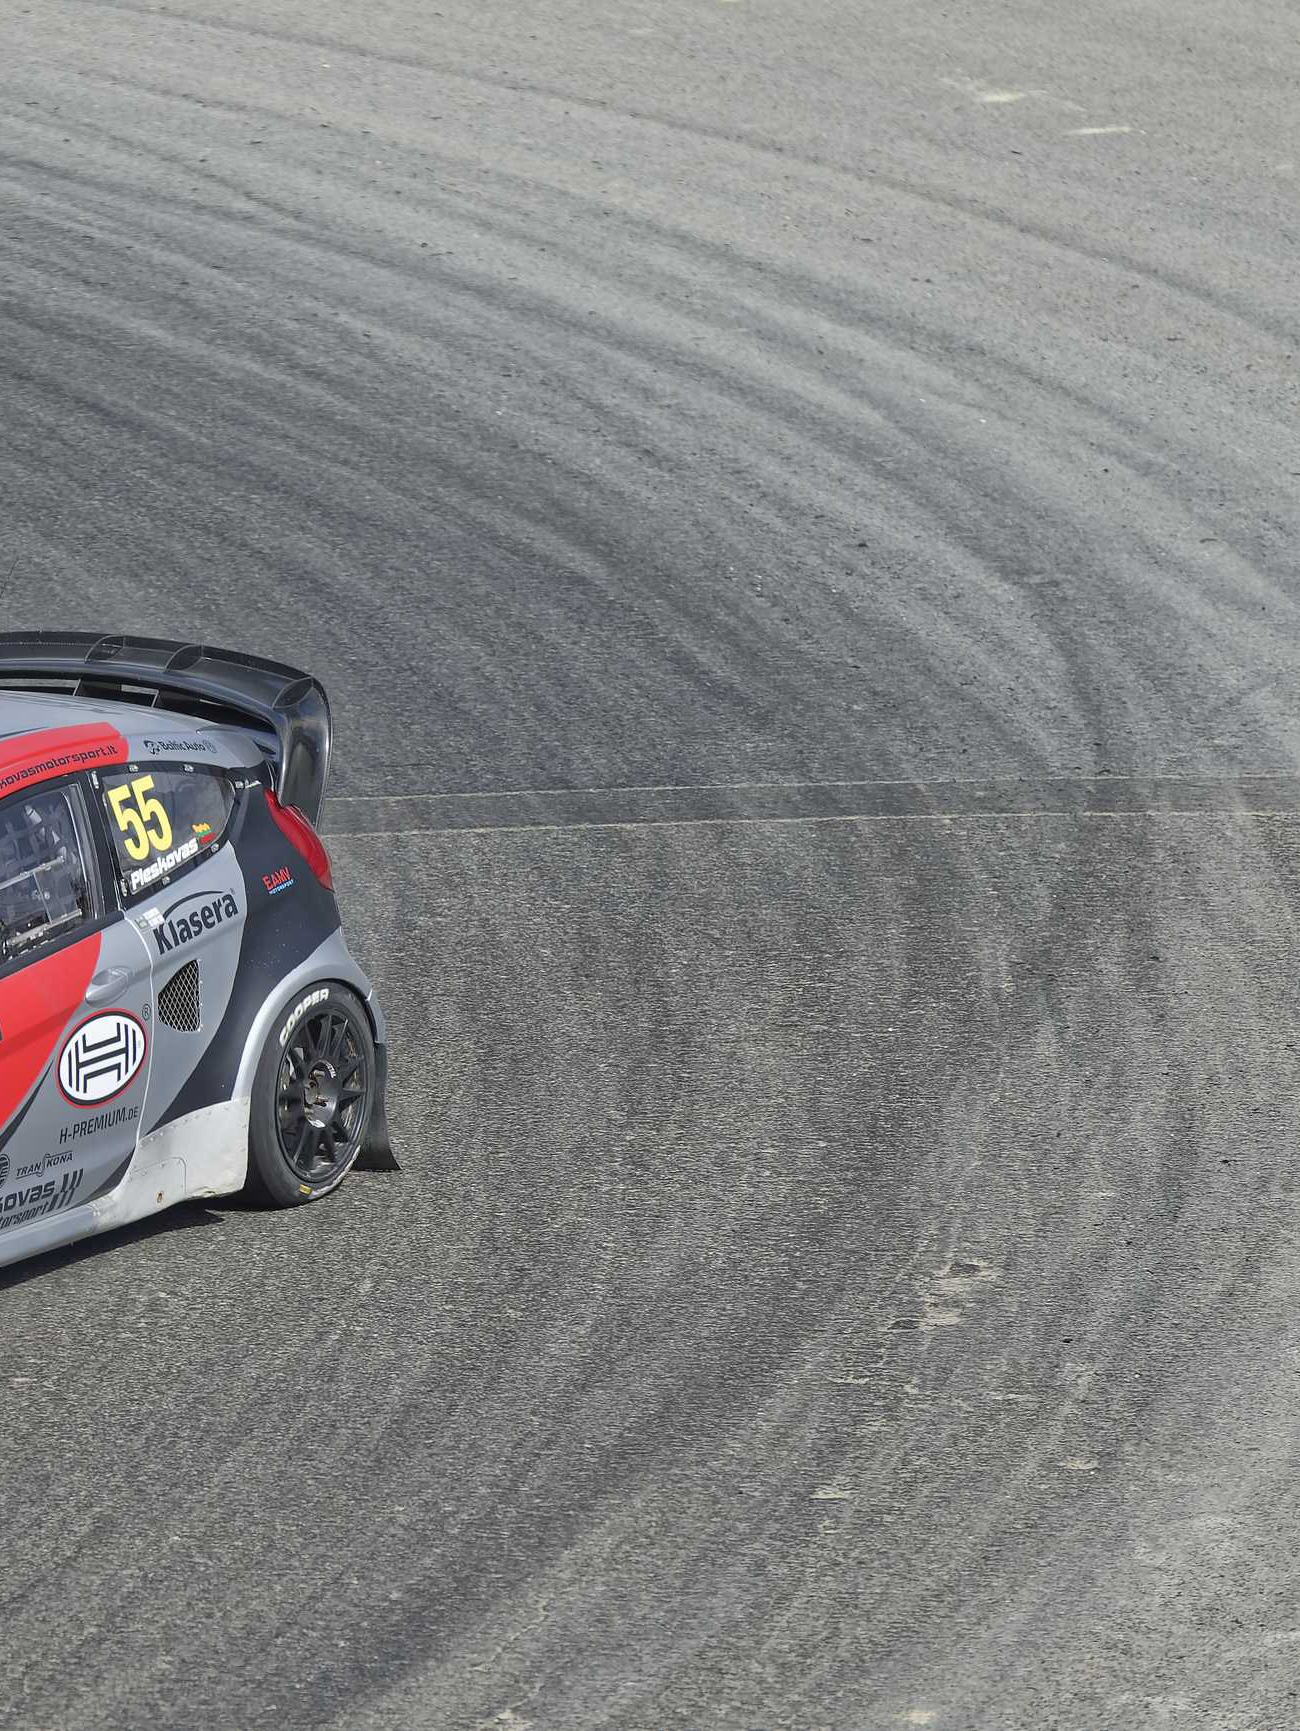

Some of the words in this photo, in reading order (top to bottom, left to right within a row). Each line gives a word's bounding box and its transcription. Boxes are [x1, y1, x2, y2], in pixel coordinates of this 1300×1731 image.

[108, 775, 172, 860] 55
[131, 837, 198, 890] Pleskovas
[152, 892, 238, 955] Klasera
[278, 988, 330, 1047] COOPER
[59, 1106, 138, 1145] H-PREMIUM.DE
